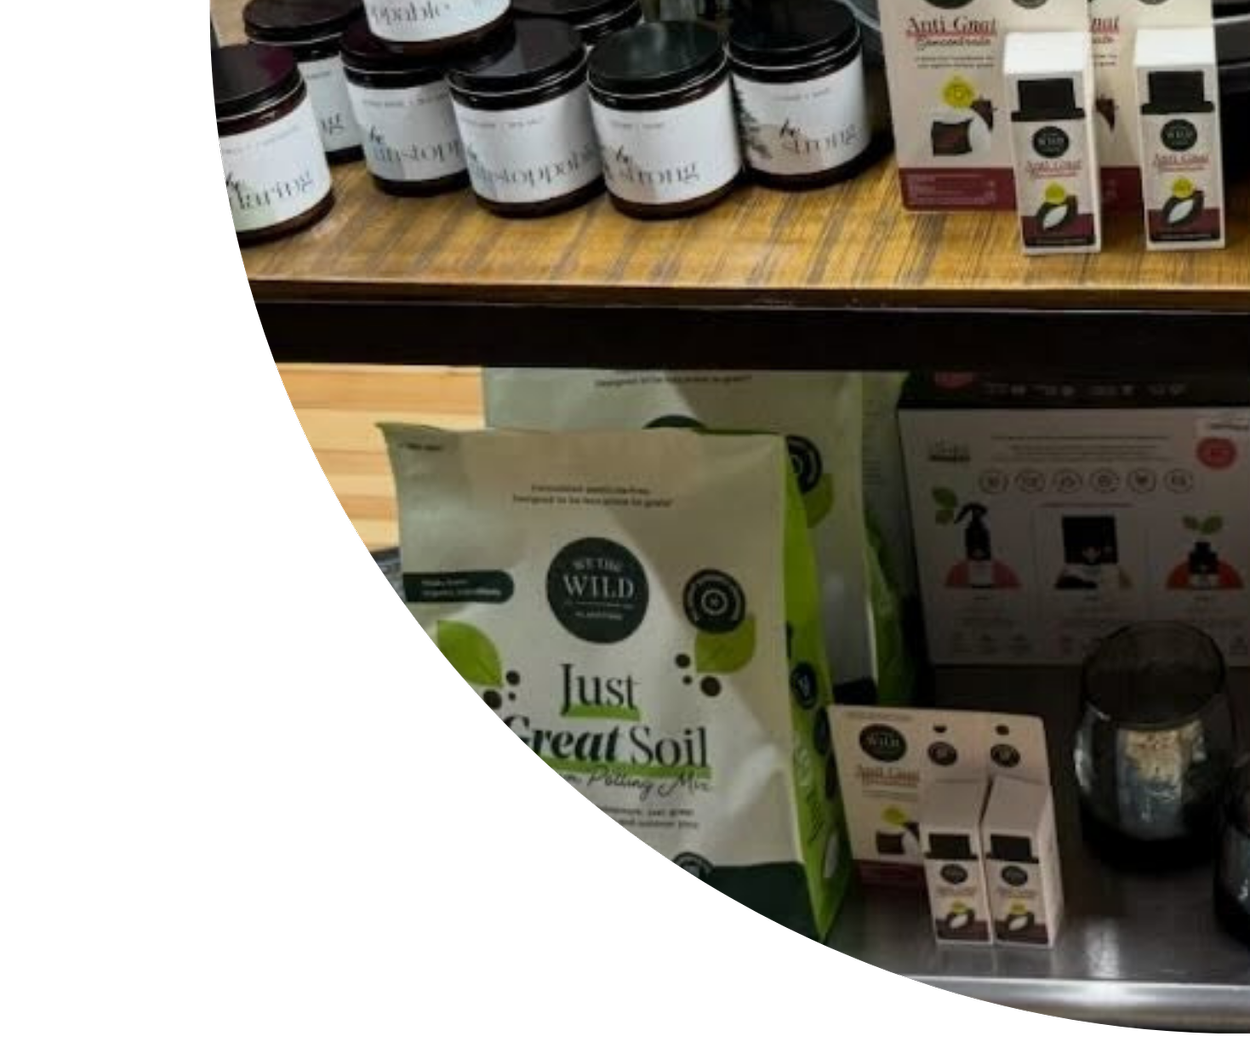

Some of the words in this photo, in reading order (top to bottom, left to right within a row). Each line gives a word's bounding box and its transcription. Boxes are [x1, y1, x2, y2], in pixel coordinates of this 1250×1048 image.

[906, 15, 945, 35] Anti
[953, 15, 998, 34] Gnat
[562, 574, 635, 599] WILD
[559, 663, 642, 717] Just
[629, 725, 708, 769] Soil
[587, 766, 653, 802] Potting
